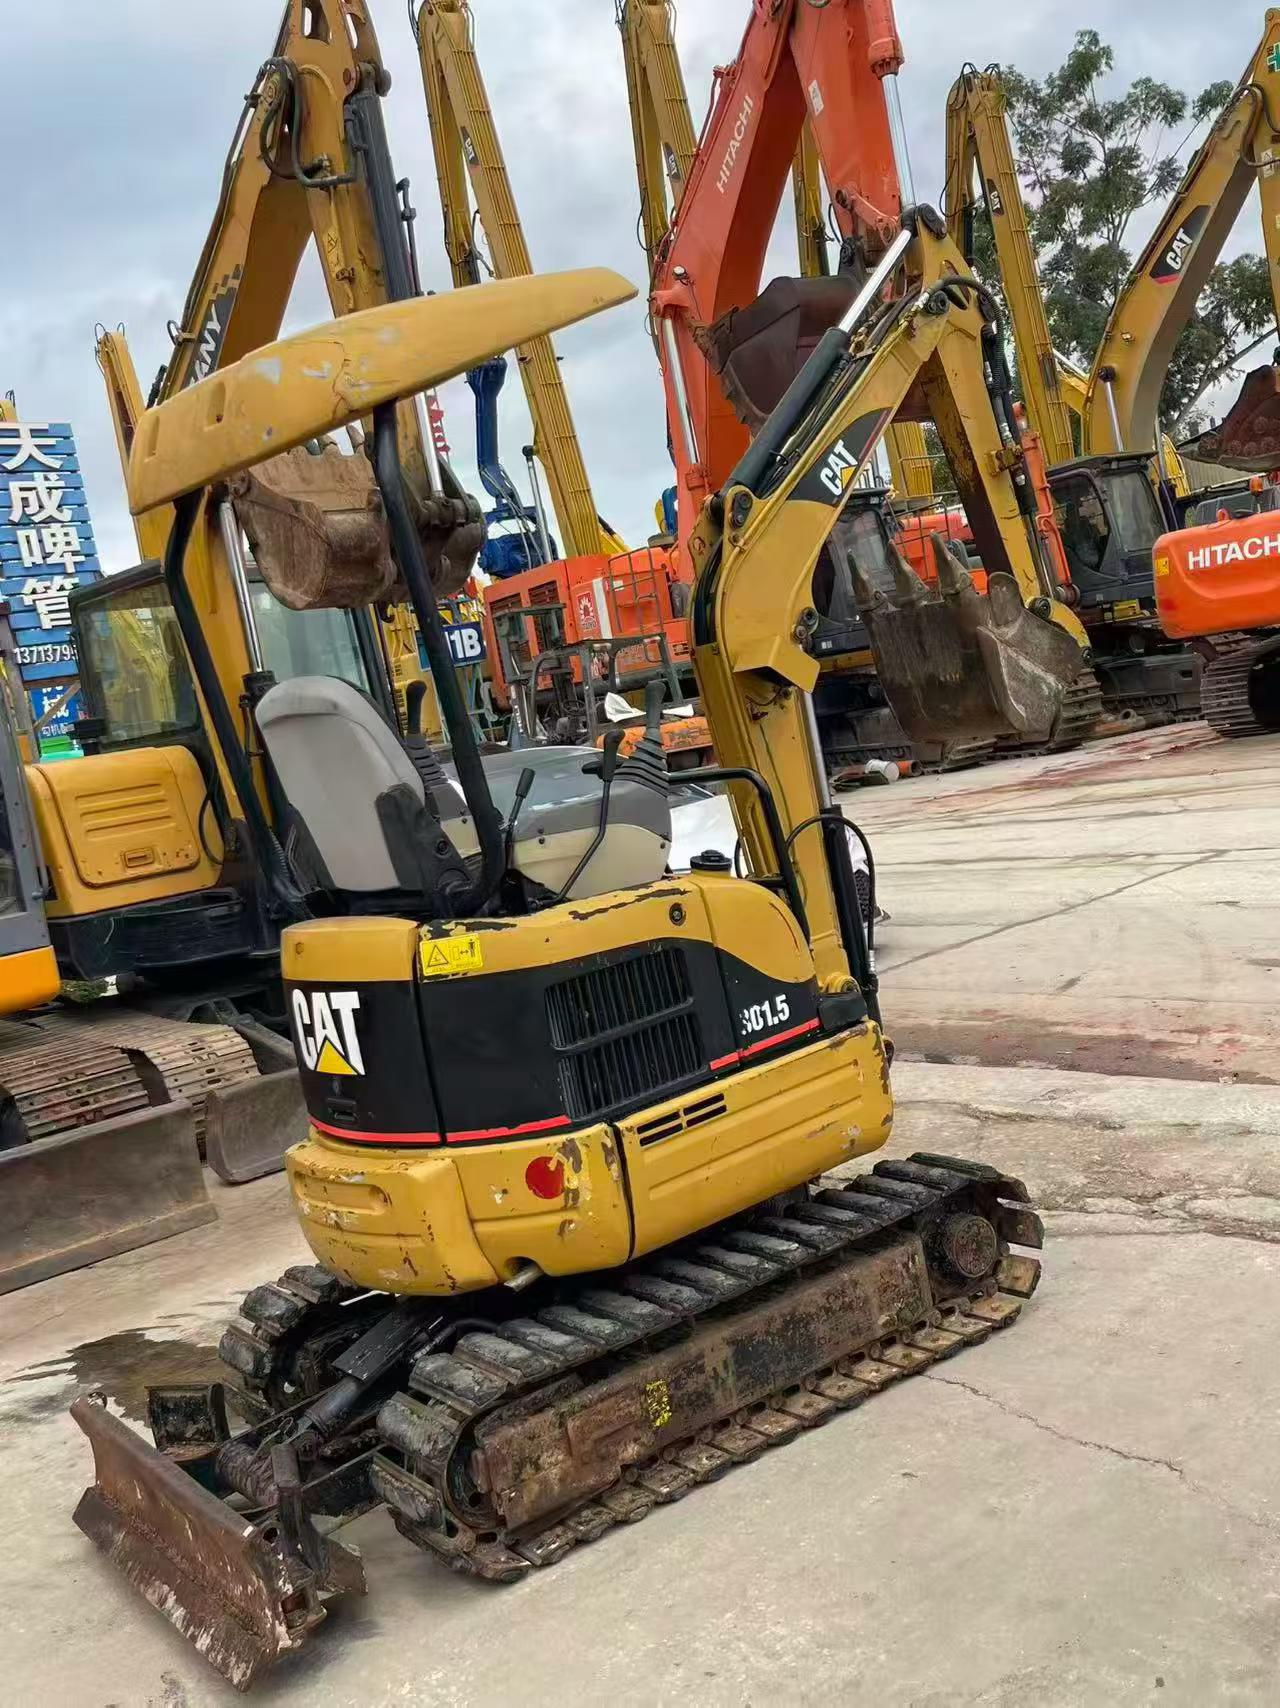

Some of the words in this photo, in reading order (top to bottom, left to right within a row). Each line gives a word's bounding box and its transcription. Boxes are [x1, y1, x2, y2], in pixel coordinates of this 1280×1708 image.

[716, 95, 753, 194] HITACHI
[990, 190, 1001, 211] CAT
[1165, 227, 1193, 270] CAT
[189, 303, 221, 387] ANY
[820, 439, 858, 496] CAT
[0, 422, 86, 630] 天成啤管
[444, 628, 481, 659] 1B
[292, 988, 366, 1075] CAT
